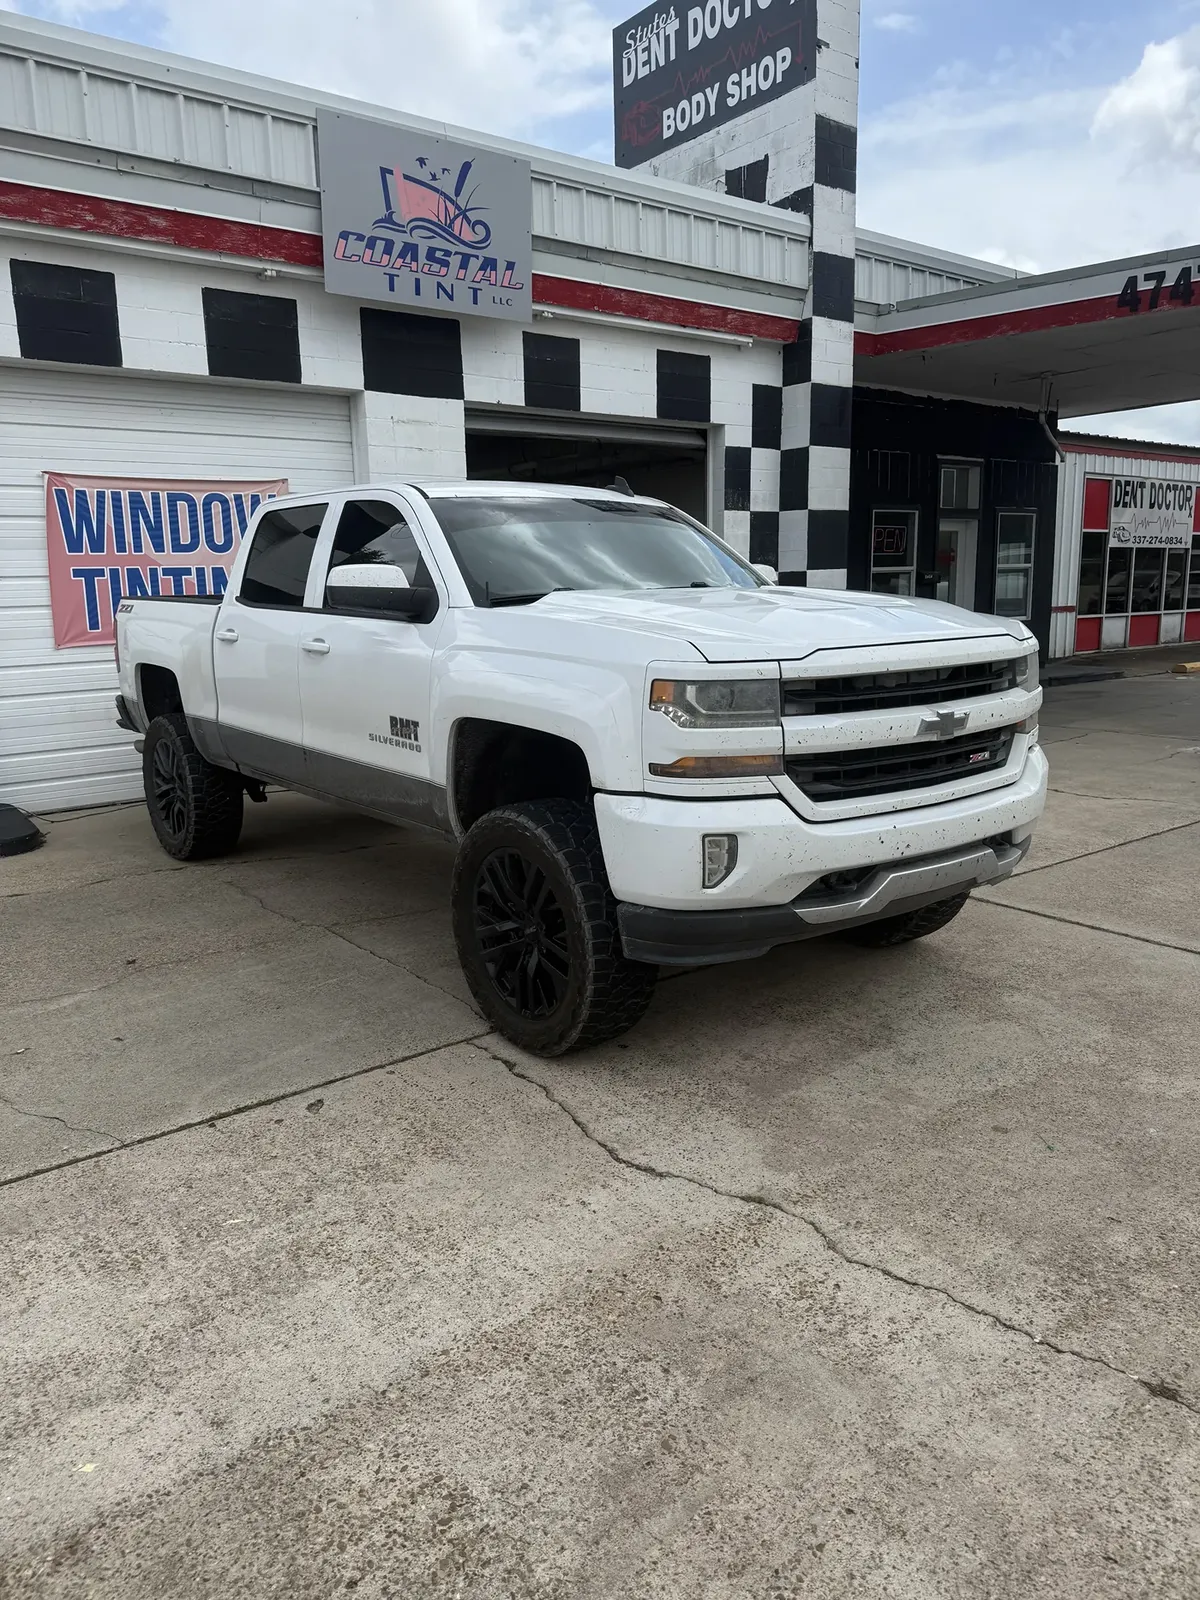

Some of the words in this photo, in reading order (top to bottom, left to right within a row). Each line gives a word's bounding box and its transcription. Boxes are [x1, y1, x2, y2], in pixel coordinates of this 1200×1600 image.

[622, 18, 680, 88] DENT
[662, 82, 720, 140] BODY
[726, 47, 792, 107] SHOP
[333, 229, 524, 290] COASTAL
[383, 272, 483, 305] TINT
[492, 295, 513, 307] LLC
[1117, 265, 1200, 312] 474
[1113, 479, 1147, 509] DENT
[873, 528, 906, 552] PEN
[1131, 535, 1183, 545] 337-274-0834
[368, 732, 422, 754] SILVERADO
